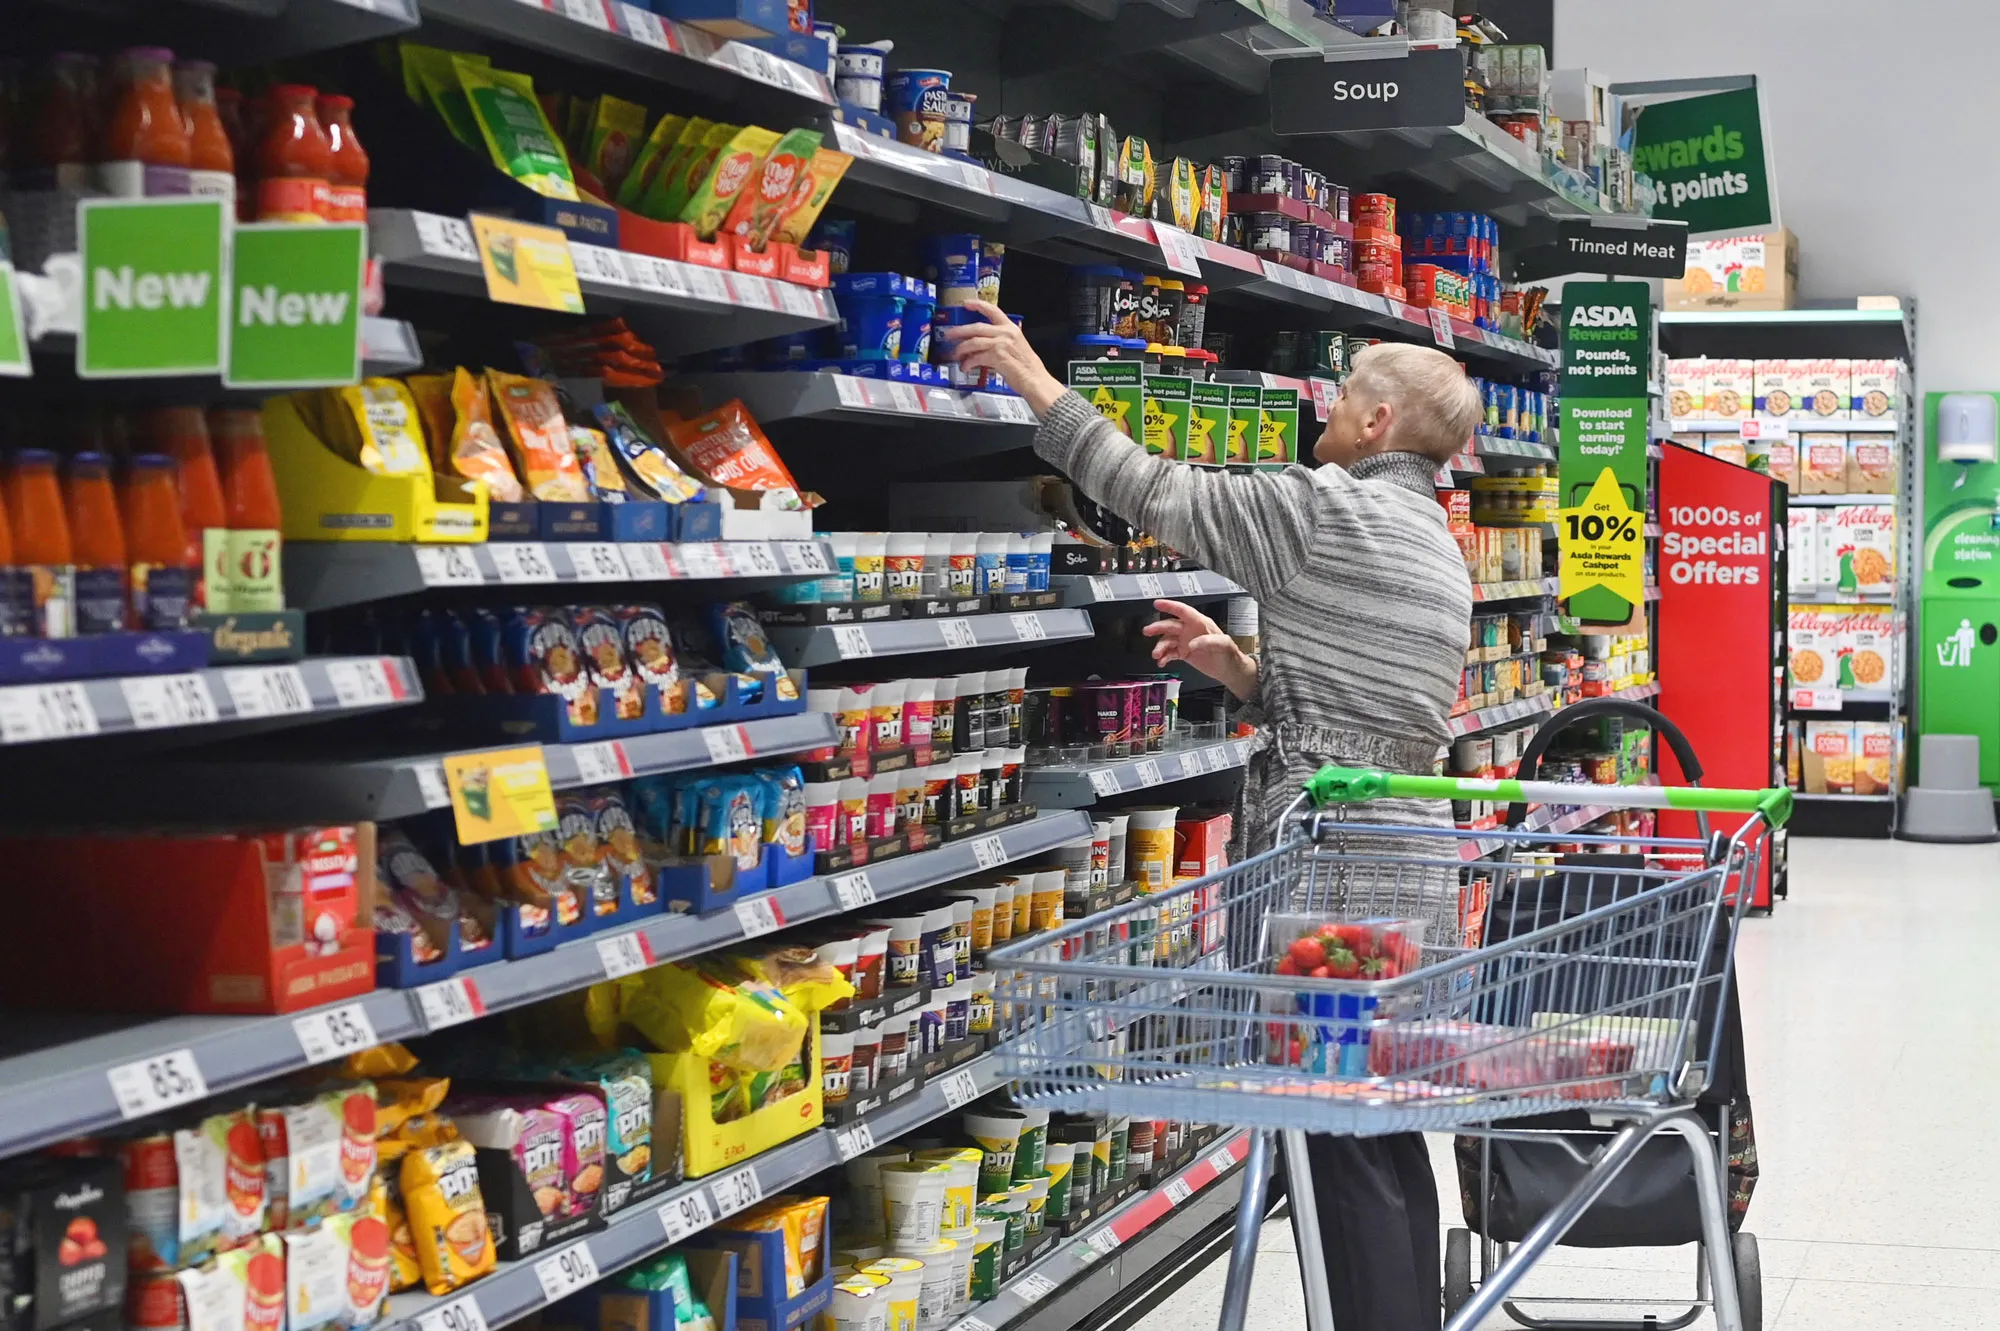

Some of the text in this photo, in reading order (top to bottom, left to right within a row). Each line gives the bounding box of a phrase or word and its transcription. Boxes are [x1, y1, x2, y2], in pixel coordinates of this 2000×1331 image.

[924, 90, 947, 102] PAST
[1333, 80, 1399, 102] Soup
[922, 101, 947, 114] SAU
[1634, 125, 1745, 172] ewards
[1671, 170, 1748, 208] points
[1568, 238, 1675, 259] Tinned Meat
[94, 266, 212, 312] New
[239, 286, 349, 328] New
[1113, 288, 1139, 312] Soba
[1140, 297, 1171, 318] Soba
[1569, 305, 1638, 327] ASDA
[1568, 328, 1638, 341] Rewards
[1576, 349, 1630, 362] Pounds,
[1076, 367, 1098, 375] ASDA
[1568, 364, 1637, 377] not points
[1075, 375, 1103, 383] Pounds,
[1167, 389, 1186, 397] points
[1203, 395, 1224, 403] points
[1144, 414, 1165, 426] 0%
[1572, 408, 1632, 418] Download
[1579, 420, 1625, 430] to start
[1578, 432, 1625, 444] earning
[1594, 503, 1610, 511] Get
[1669, 506, 1762, 526] 1000s of
[1566, 515, 1636, 542] 10%
[1663, 531, 1766, 559] Special
[1954, 532, 2000, 547] cleaning
[1066, 552, 1088, 565] Soba
[1570, 552, 1631, 561] Asda Rewards
[1954, 548, 1992, 561] station
[1582, 561, 1618, 570] Cashpot
[1669, 560, 1759, 585] Offers
[856, 571, 884, 590] PO
[949, 569, 975, 587] PO
[876, 720, 902, 738] PO
[1091, 846, 1108, 856] ING
[892, 955, 919, 979] PO
[573, 1121, 607, 1150] POT
[523, 1143, 562, 1175] POT
